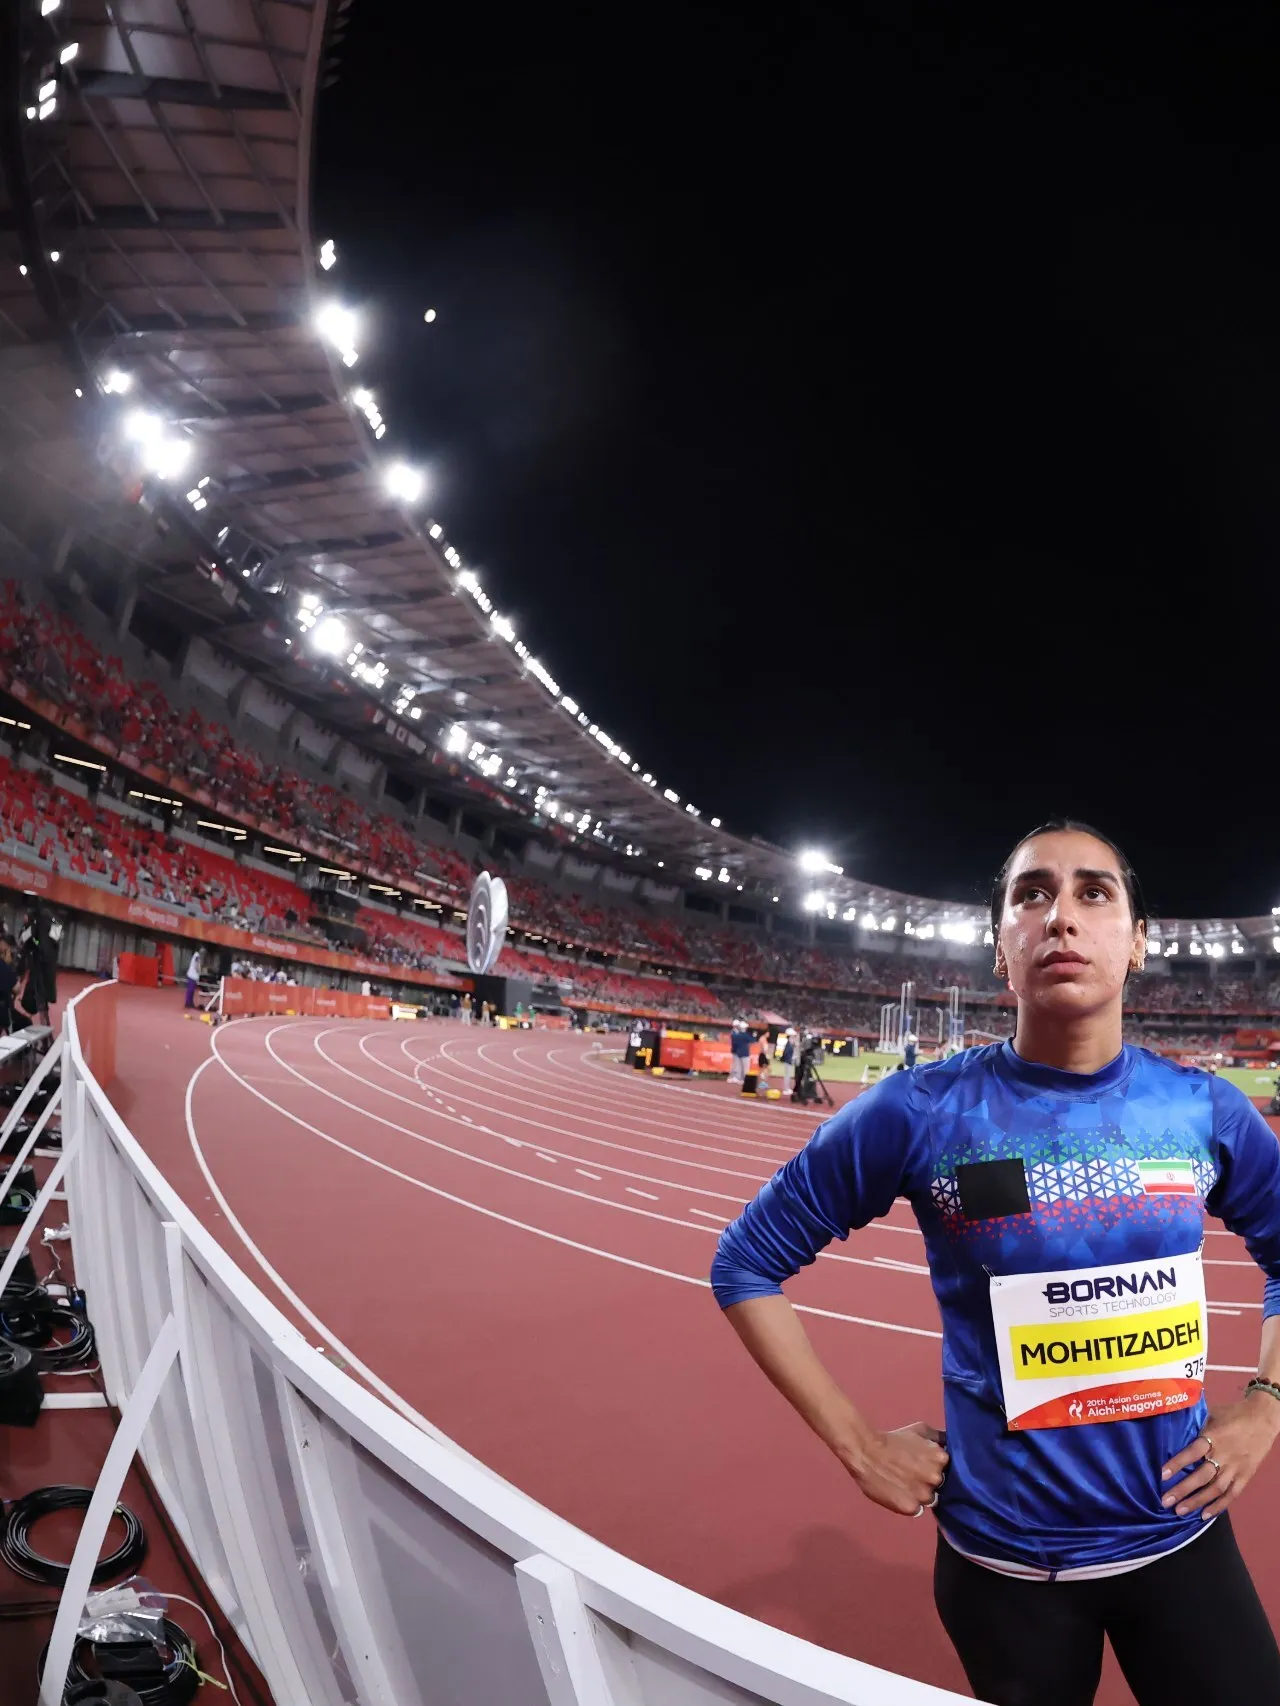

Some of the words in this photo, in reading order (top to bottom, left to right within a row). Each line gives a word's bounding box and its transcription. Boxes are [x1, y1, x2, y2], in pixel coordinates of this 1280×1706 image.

[1042, 1267, 1176, 1304] BORNAN
[1049, 1304, 1099, 1318] SPORTS
[1103, 1292, 1177, 1313] TECHNOLOGY
[1020, 1319, 1200, 1366] MOHITIZADEH
[1086, 1398, 1107, 1407] 20th
[1108, 1395, 1132, 1405] Asian
[1132, 1391, 1162, 1401] Games
[1087, 1399, 1163, 1417] Aichi-Nagoya
[1165, 1391, 1189, 1406] 2026
